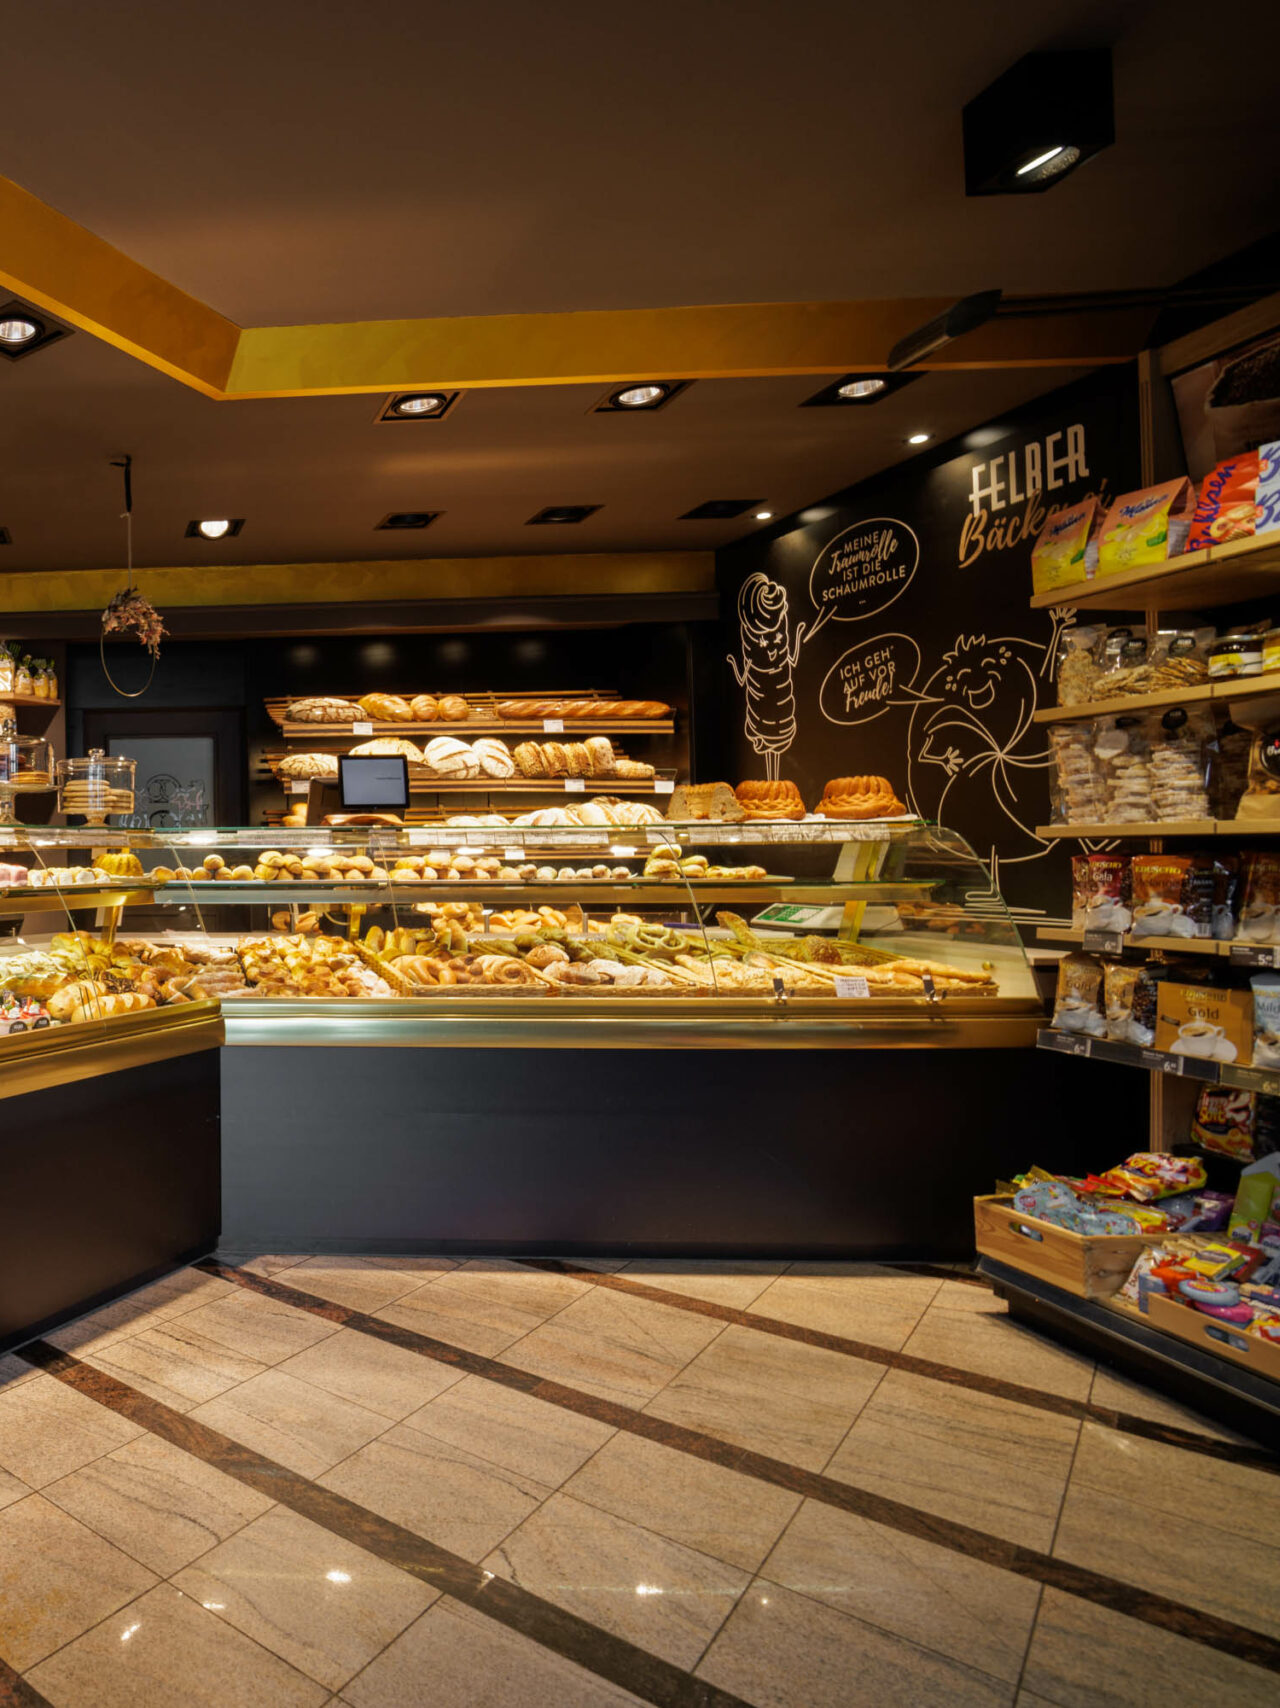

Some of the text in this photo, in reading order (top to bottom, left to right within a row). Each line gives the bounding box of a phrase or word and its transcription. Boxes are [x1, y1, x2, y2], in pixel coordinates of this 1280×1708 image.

[969, 424, 1089, 518] FELBER
[958, 478, 1112, 569] Bäcki
[828, 528, 899, 576] Traumrolle
[843, 530, 880, 554] MEINE
[822, 565, 906, 602] SCHAUMROLLE
[843, 559, 882, 582] IST DIE
[840, 660, 861, 680] ICH
[843, 660, 896, 694] AUF VOR
[845, 674, 894, 713] Freude!
[1187, 1006, 1219, 1020] Gold
